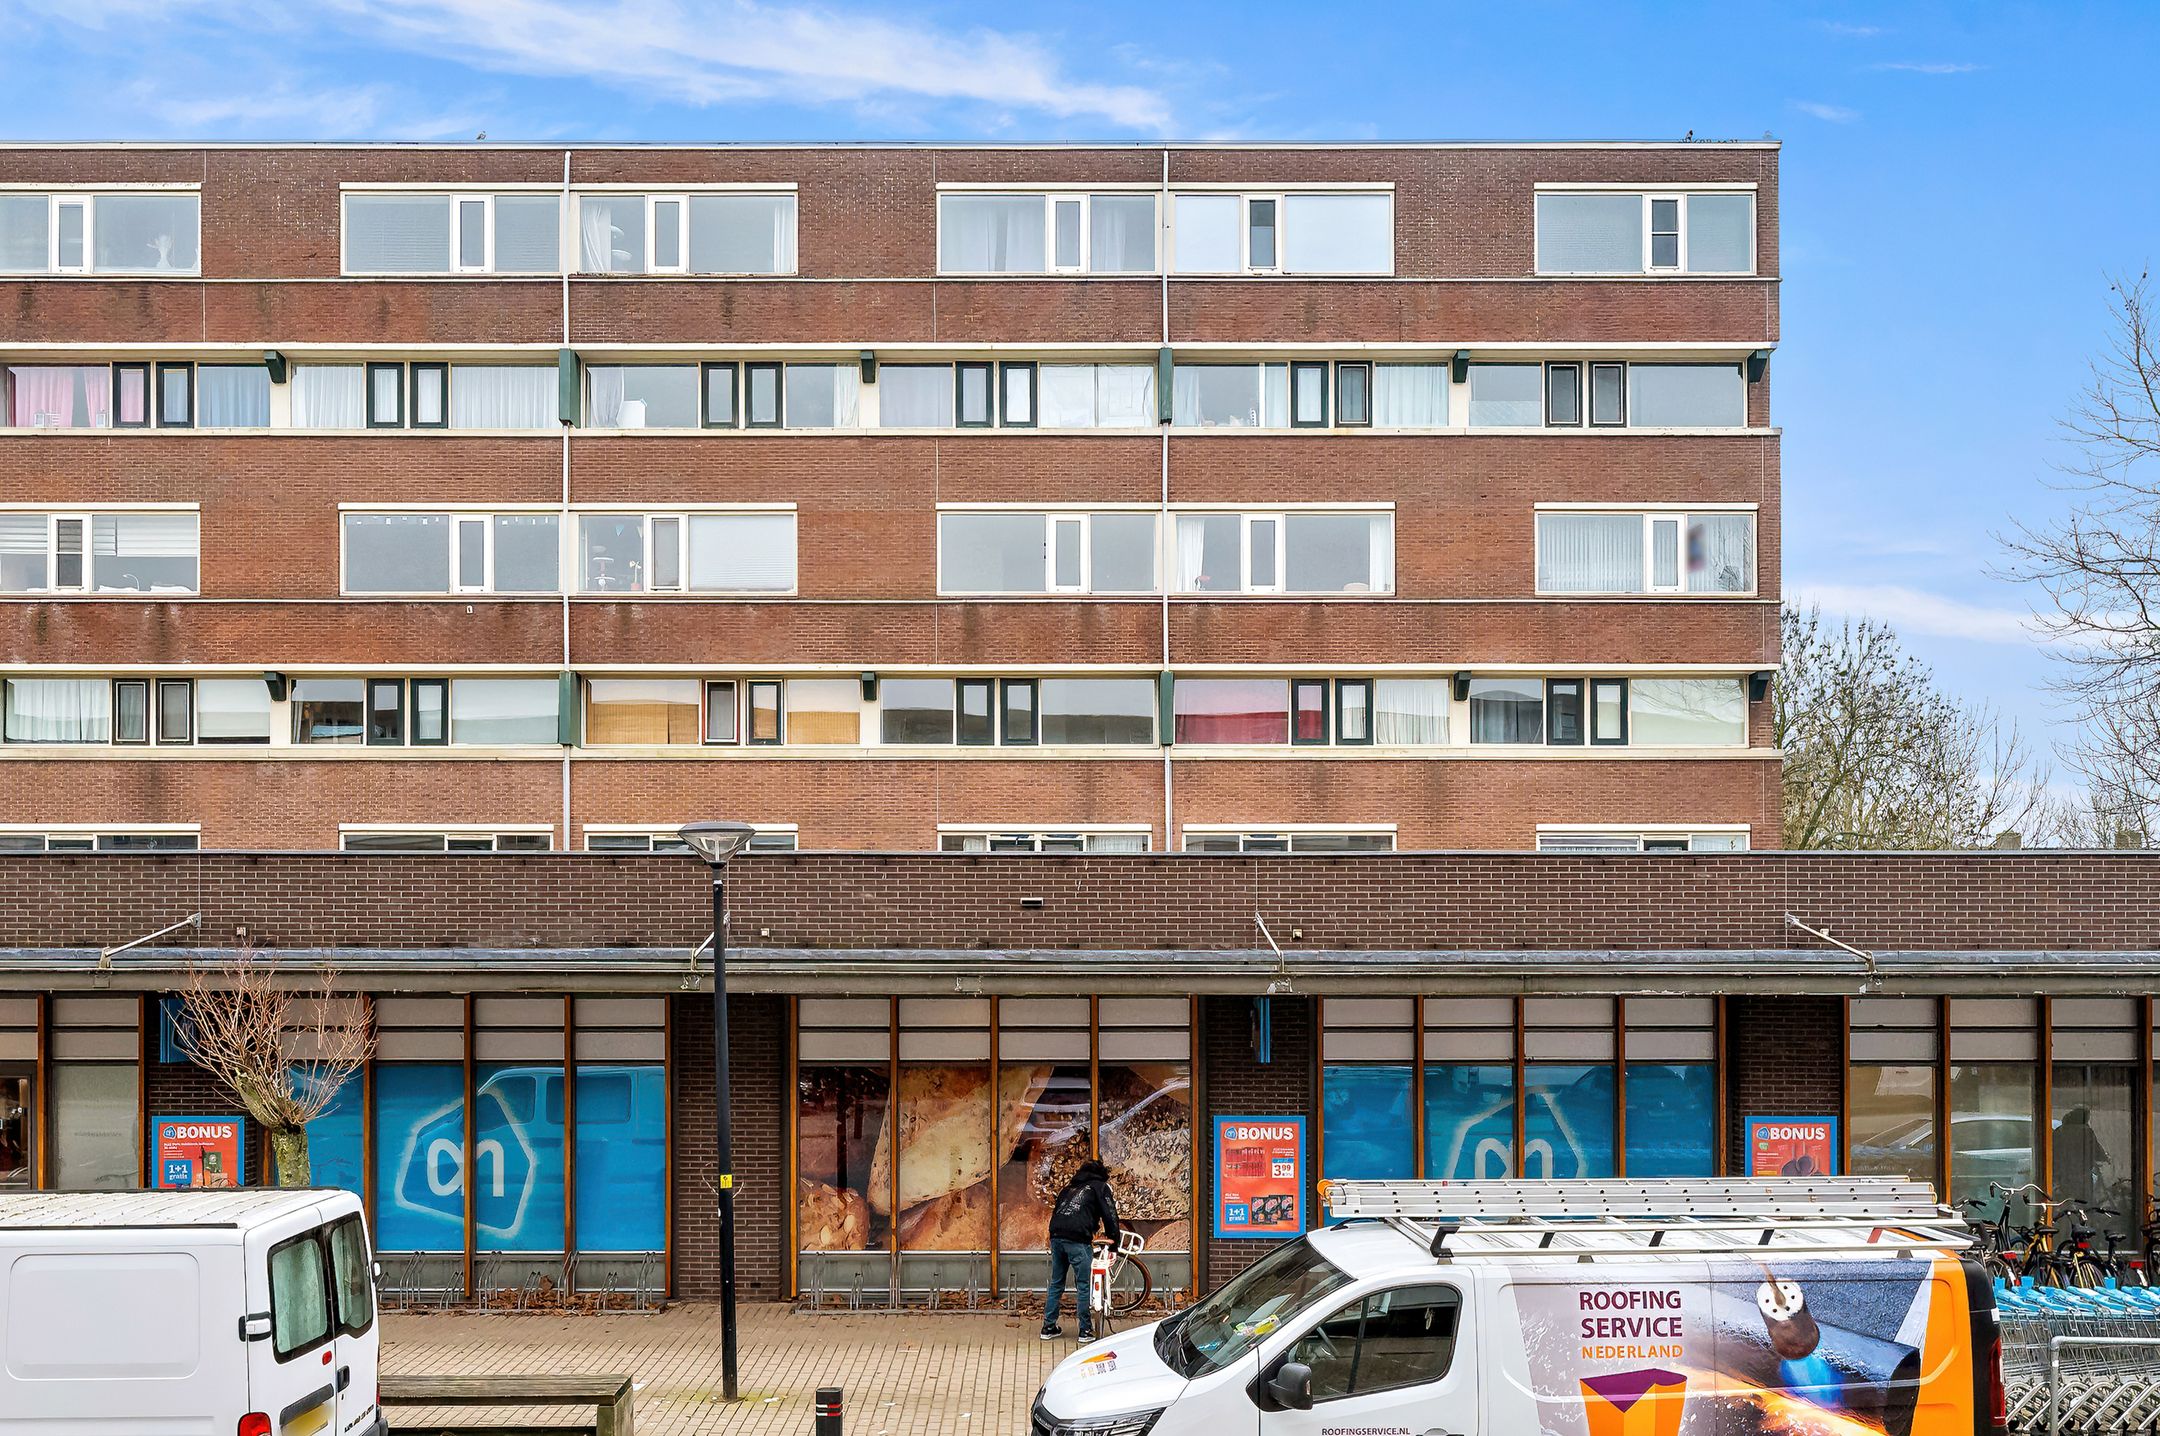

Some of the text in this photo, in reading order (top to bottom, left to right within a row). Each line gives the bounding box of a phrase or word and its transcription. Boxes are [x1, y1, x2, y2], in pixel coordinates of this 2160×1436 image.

[177, 1125, 233, 1139] BONUS
[1237, 1127, 1294, 1140] BONUS
[1769, 1127, 1826, 1140] BONUS
[168, 1164, 188, 1173] 1+1
[1228, 1207, 1245, 1216] 1+1
[1579, 1290, 1682, 1310] ROOFING
[1581, 1316, 1683, 1338] SERVICE
[1581, 1344, 1684, 1359] NEDERLAND
[1321, 1427, 1411, 1436] ROOFINGSERVICE.NL
